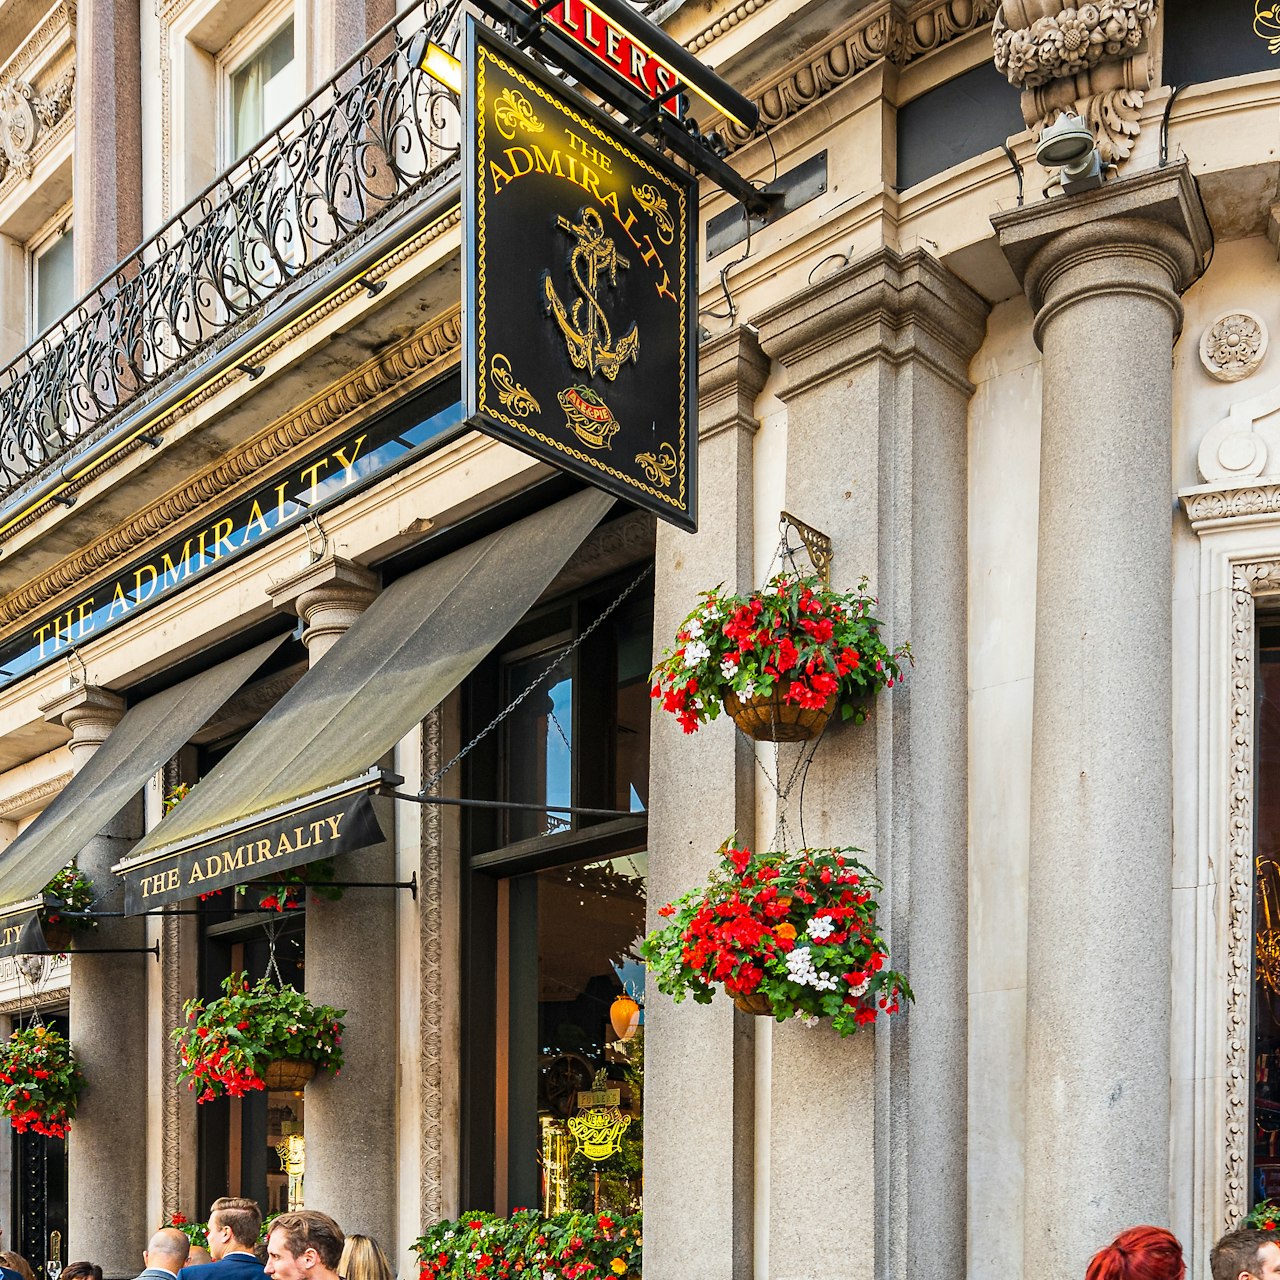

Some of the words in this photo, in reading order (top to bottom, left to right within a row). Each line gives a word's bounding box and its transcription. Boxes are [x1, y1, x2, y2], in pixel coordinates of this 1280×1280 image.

[563, 127, 613, 175] THE
[489, 144, 678, 303] ADMIRALTY
[32, 597, 96, 662] THE
[105, 434, 368, 623] ADMIRALTY
[139, 867, 182, 899] THE
[187, 812, 345, 885] ADMIRALTY
